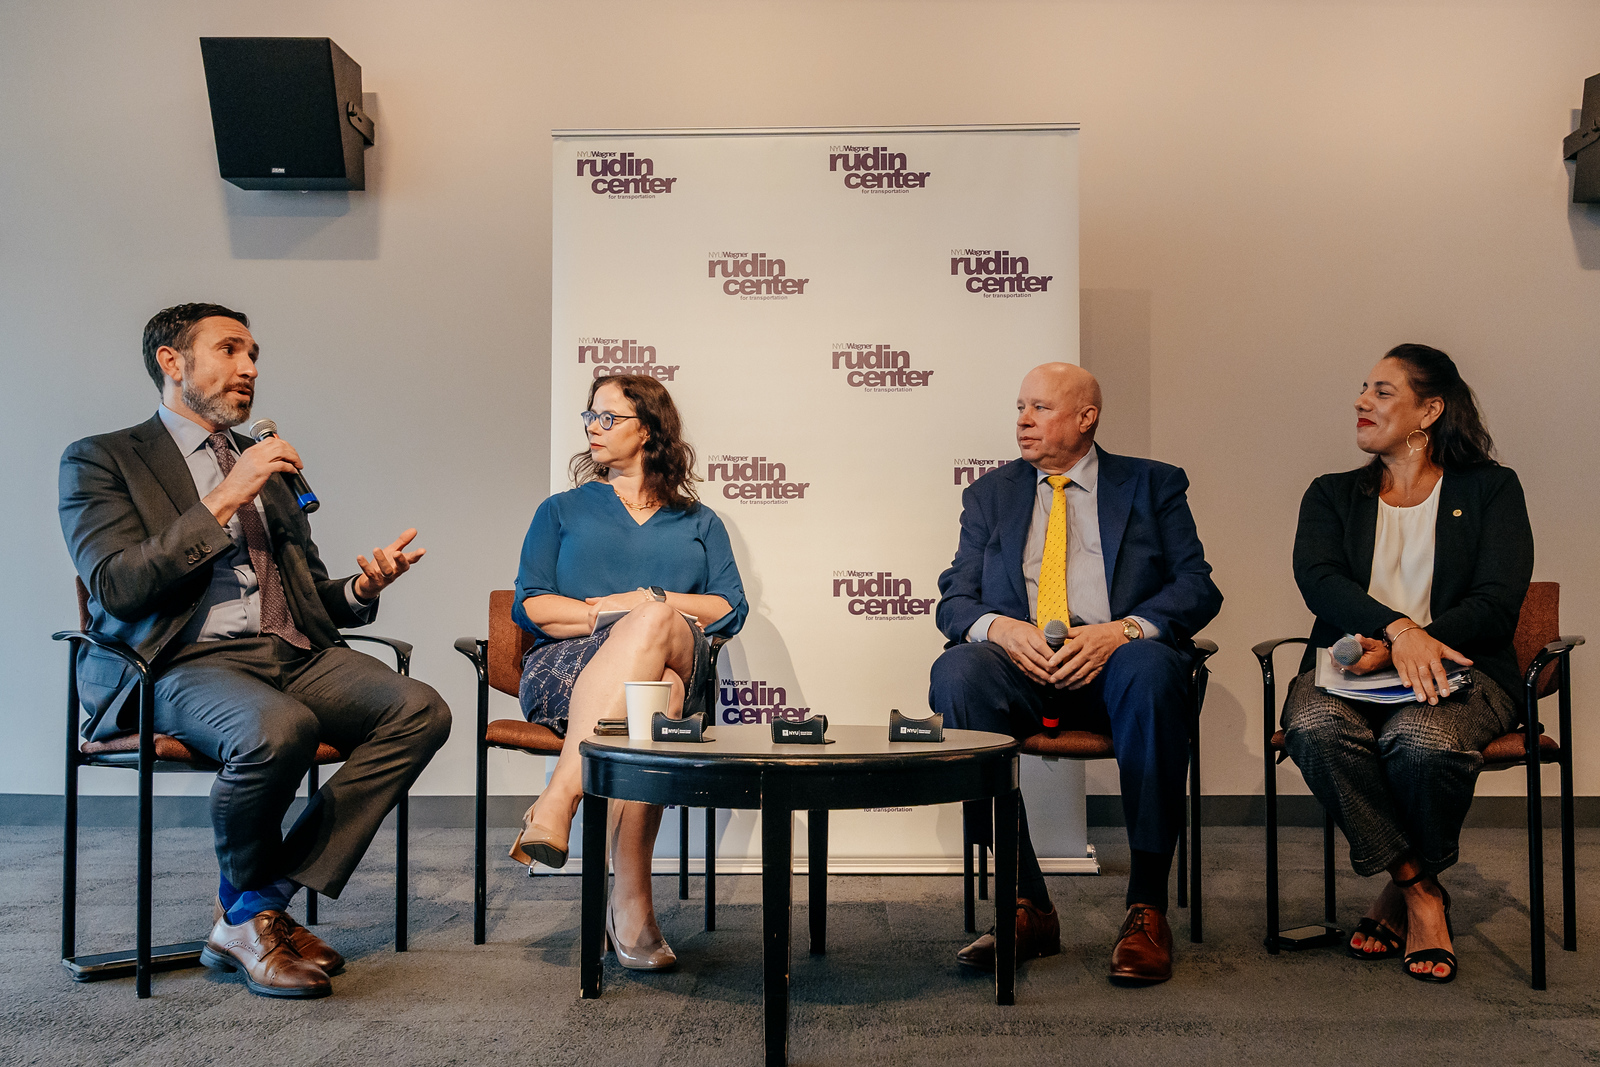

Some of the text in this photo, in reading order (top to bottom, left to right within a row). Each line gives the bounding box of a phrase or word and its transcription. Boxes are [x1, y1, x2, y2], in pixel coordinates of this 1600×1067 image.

[577, 152, 653, 177] rudin
[829, 147, 907, 171] rudin
[591, 173, 677, 194] center
[844, 168, 931, 189] center
[708, 253, 785, 278] rudin
[951, 251, 1029, 275] rudin
[723, 274, 809, 295] center
[966, 272, 1053, 293] center
[578, 340, 656, 364] rudin
[832, 344, 910, 369] rudin
[593, 361, 680, 382] center
[847, 366, 934, 387] center
[708, 457, 786, 482] rudin
[723, 478, 810, 499] center
[833, 572, 911, 597] rudin
[848, 594, 936, 615] center
[720, 679, 748, 687] Wagner
[720, 681, 786, 706] udin
[722, 703, 811, 724] center
